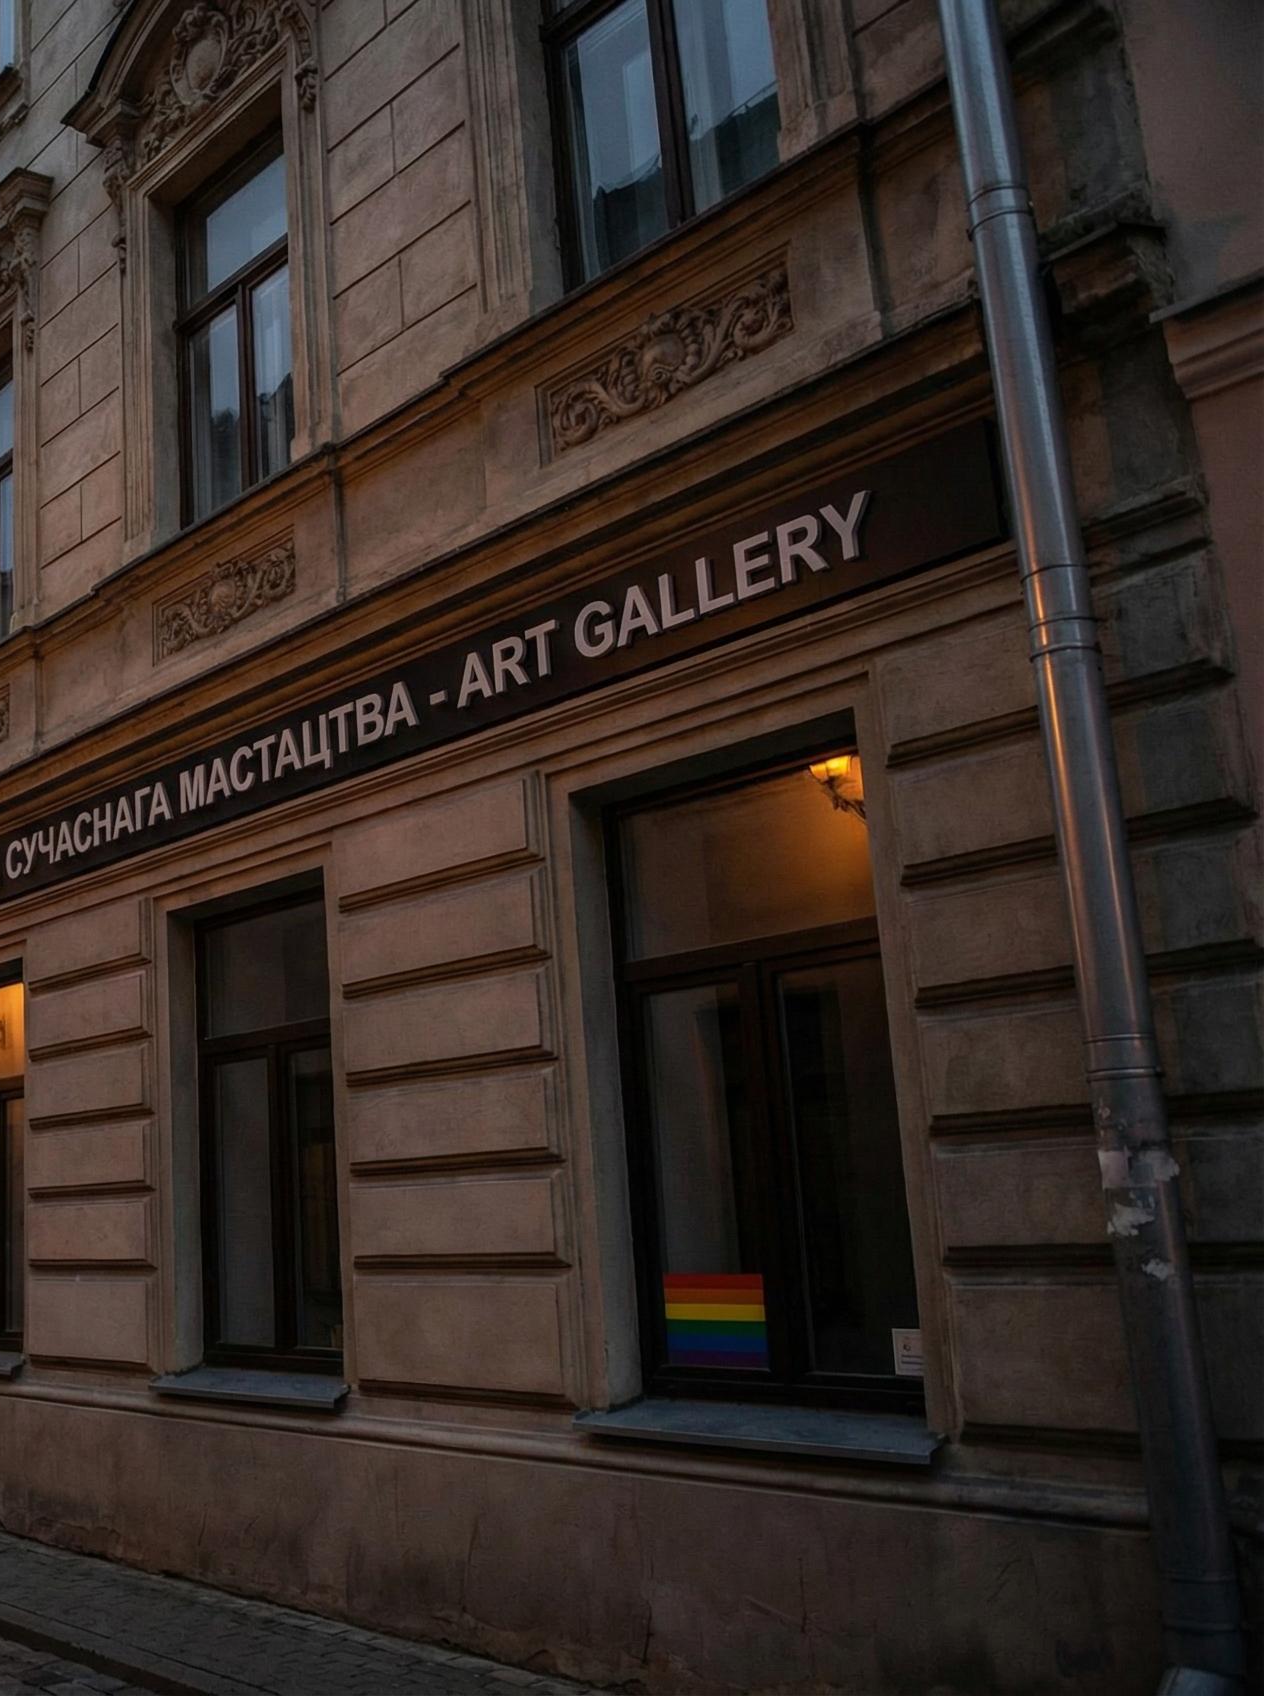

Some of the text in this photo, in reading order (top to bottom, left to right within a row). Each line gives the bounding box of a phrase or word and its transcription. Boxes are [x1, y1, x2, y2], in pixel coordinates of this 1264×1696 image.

[5, 781, 175, 880] СУЧАСНАГА
[179, 681, 420, 812] МАСТАЦТВА
[429, 688, 448, 705] -
[456, 619, 560, 709] ART
[574, 489, 872, 658] GALLERY
